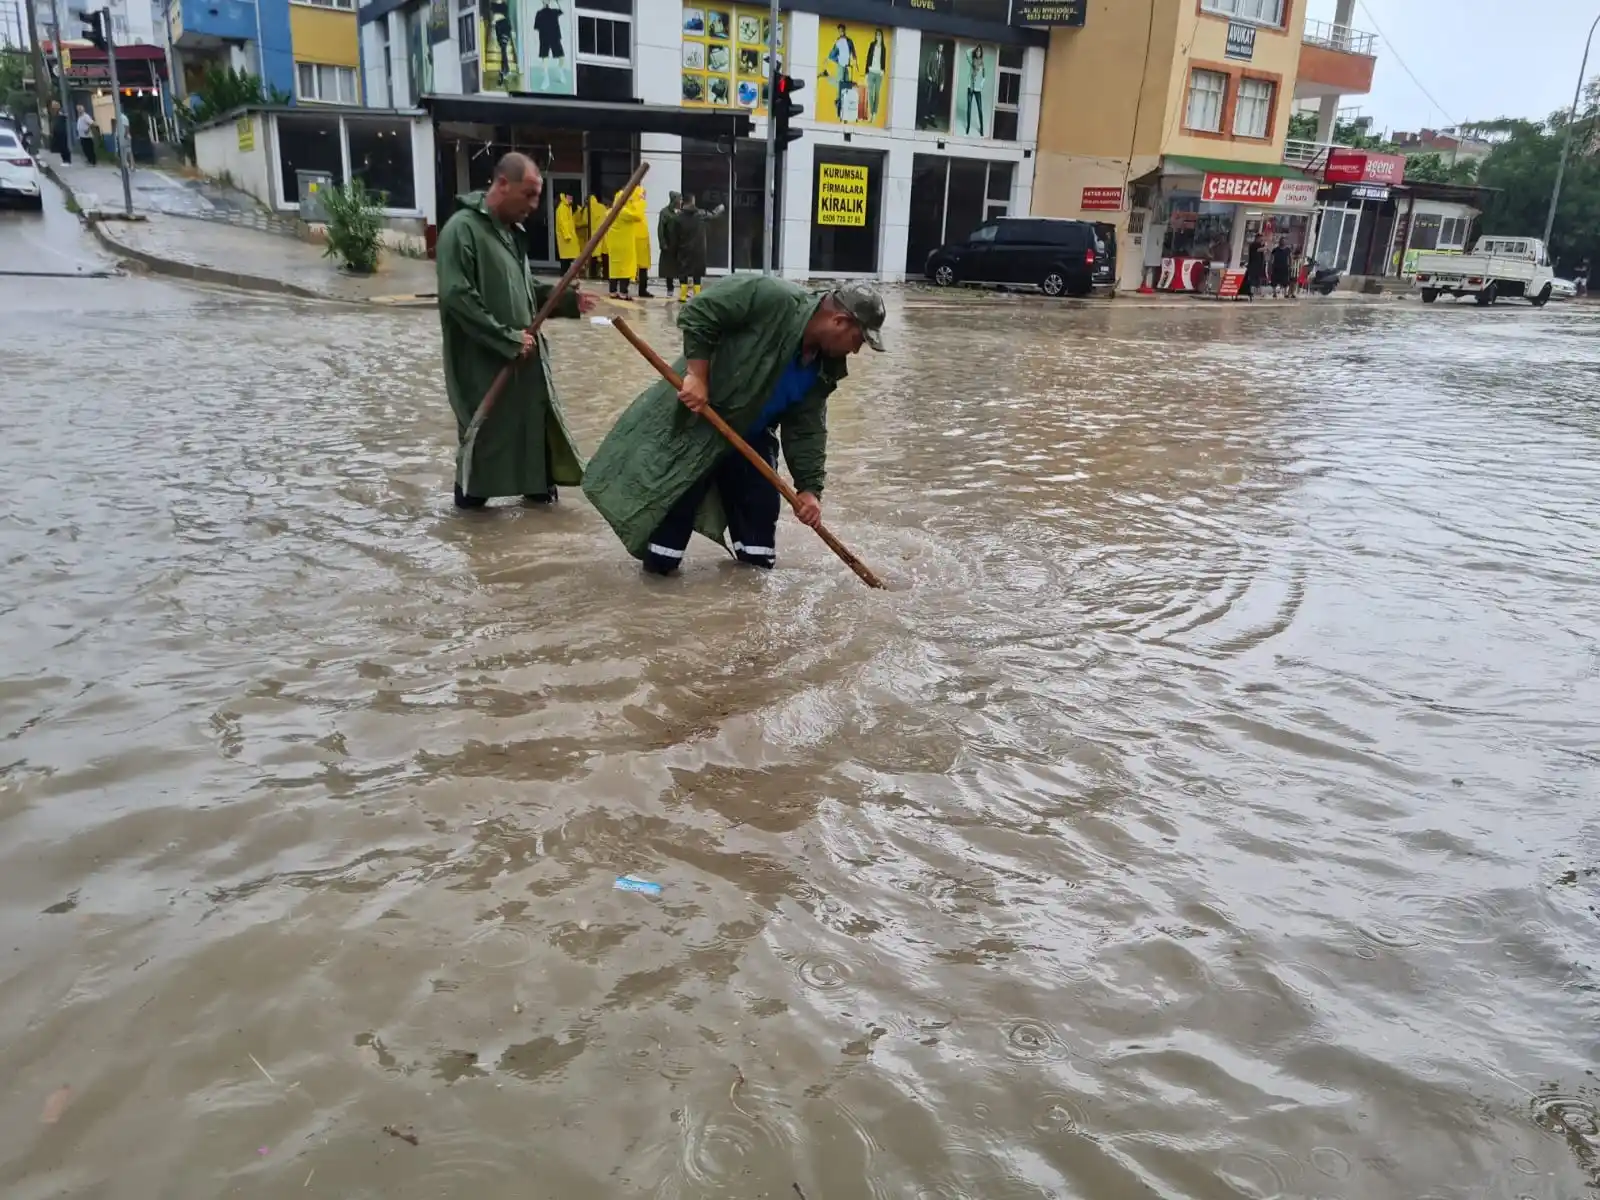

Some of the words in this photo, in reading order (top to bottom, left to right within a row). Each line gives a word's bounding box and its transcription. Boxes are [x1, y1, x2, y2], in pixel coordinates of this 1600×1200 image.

[1229, 25, 1254, 45] AVUKAT
[823, 167, 864, 180] KURUMSAL
[822, 181, 864, 194] FİRMALARA
[1208, 176, 1273, 199] ÇEREZCİM
[821, 194, 863, 214] KİRALIK
